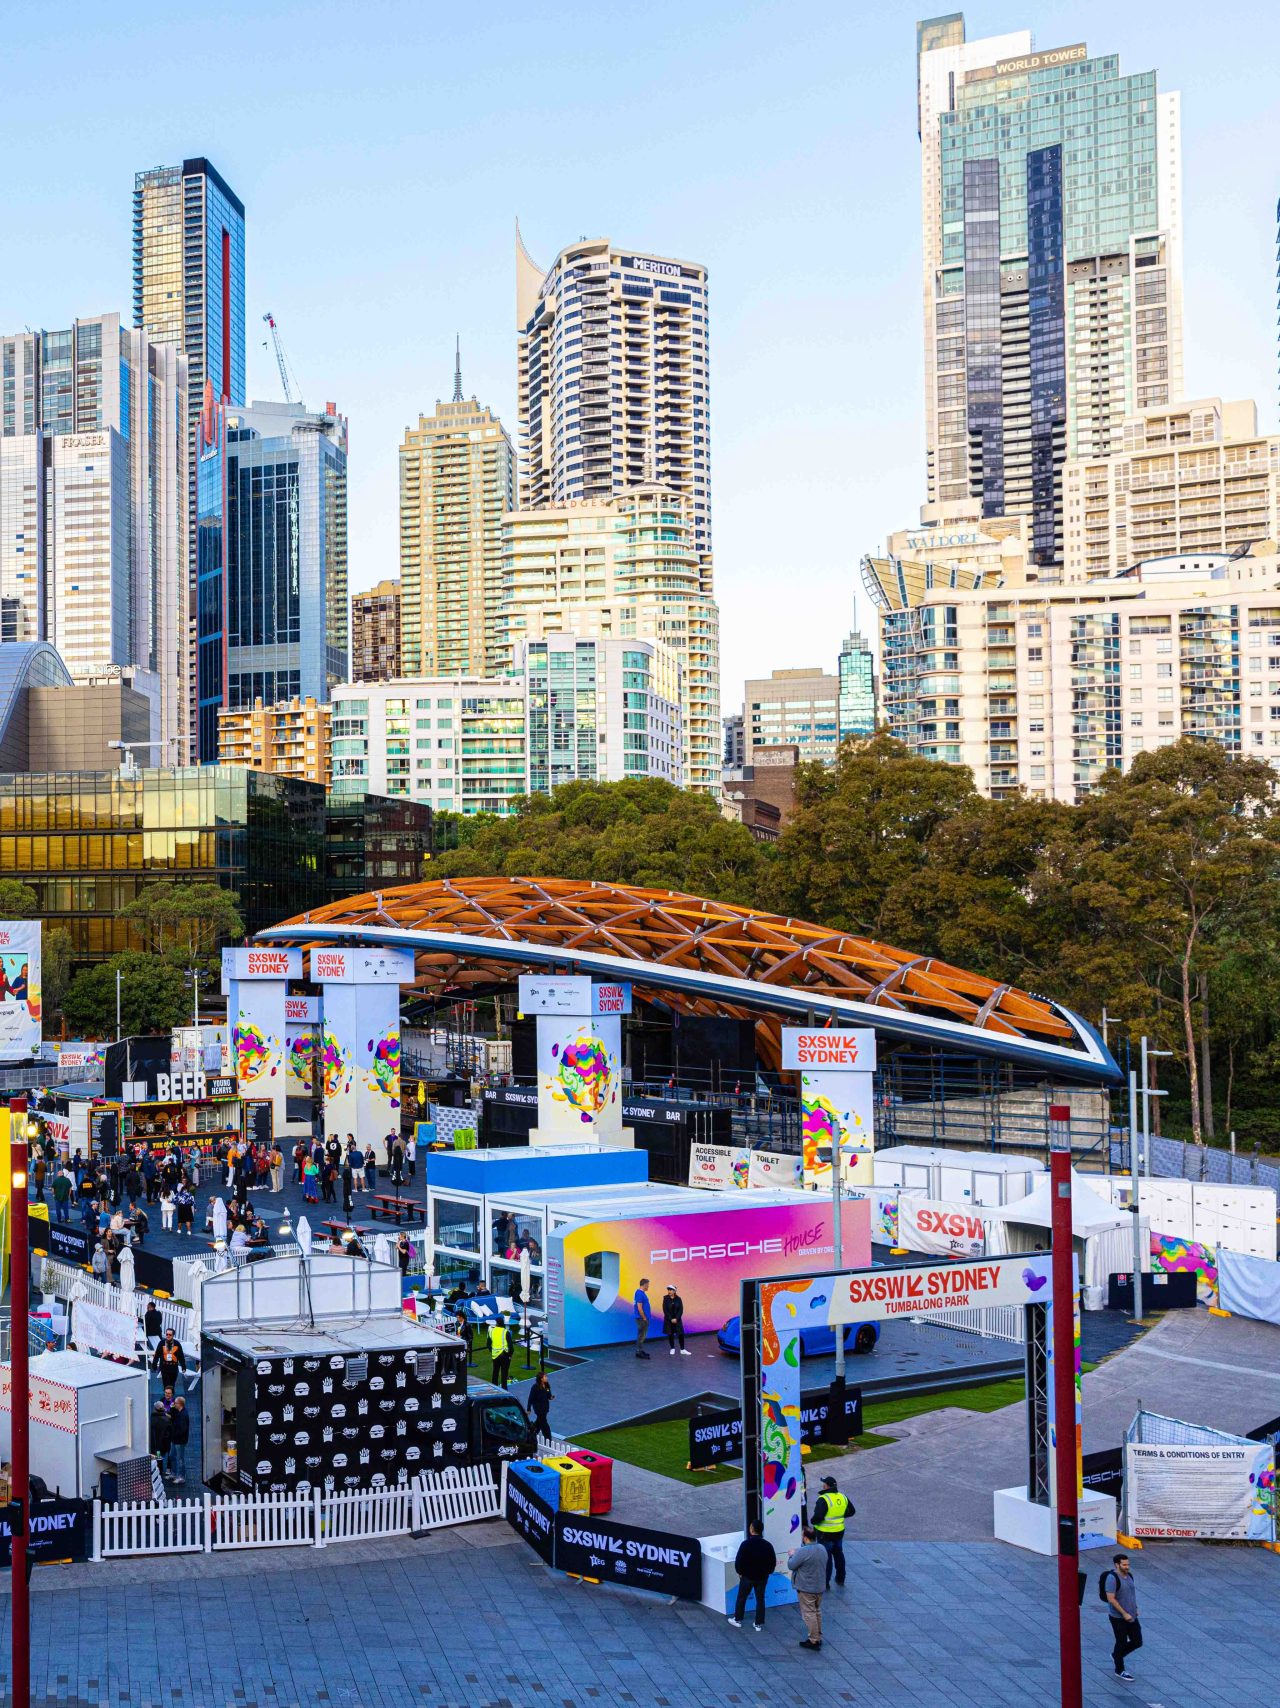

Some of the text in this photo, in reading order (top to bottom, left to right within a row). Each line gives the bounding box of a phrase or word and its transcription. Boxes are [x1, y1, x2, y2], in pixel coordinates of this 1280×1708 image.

[996, 47, 1086, 74] WORLD TOWER
[633, 258, 680, 276] MERITON
[62, 435, 105, 448] FRASER
[550, 499, 605, 509] RYDGES
[248, 953, 279, 963] SXSW
[317, 954, 338, 965] SXSW
[248, 963, 289, 974] SYDNEY
[317, 966, 346, 977] SYDNEY
[599, 986, 618, 998] SXSW
[285, 1000, 301, 1010] XSW
[599, 999, 625, 1012] SYDNEY
[286, 1010, 309, 1018] DNEY
[798, 1036, 842, 1049] SXSW
[171, 1051, 181, 1063] NEY
[798, 1050, 859, 1064] SYDNEY
[157, 1071, 206, 1102] BEER
[213, 1079, 231, 1088] YOUNG
[211, 1086, 232, 1095] HENRYS
[485, 1091, 497, 1099] BAR
[526, 1095, 538, 1104] SYD
[629, 1108, 655, 1118] SYDNEY
[666, 1110, 681, 1121] BAR
[695, 1147, 732, 1157] ACCESSIBLE
[695, 1154, 716, 1163] TOILET
[756, 1154, 780, 1165] TOILET
[917, 1209, 984, 1240] SXSW
[67, 1234, 85, 1249] SYDNEY
[650, 1221, 825, 1264] PORSCHE HOUSE
[824, 1246, 844, 1255] DRES
[849, 1266, 1001, 1303] SXSW SYDNEY
[885, 1294, 970, 1313] TUMBALONG PARK
[695, 1425, 722, 1443] SXSW
[1133, 1449, 1158, 1458] TERMS
[1160, 1450, 1165, 1458] &
[1166, 1451, 1210, 1459] CONDITIONS
[1222, 1451, 1245, 1459] ENTRY
[508, 1483, 550, 1535] SXSW SYDNEY
[29, 1512, 77, 1533] YDNEY
[1135, 1527, 1198, 1537] SXSW SYDNEY
[563, 1526, 691, 1568] SXSW SYDNEY
